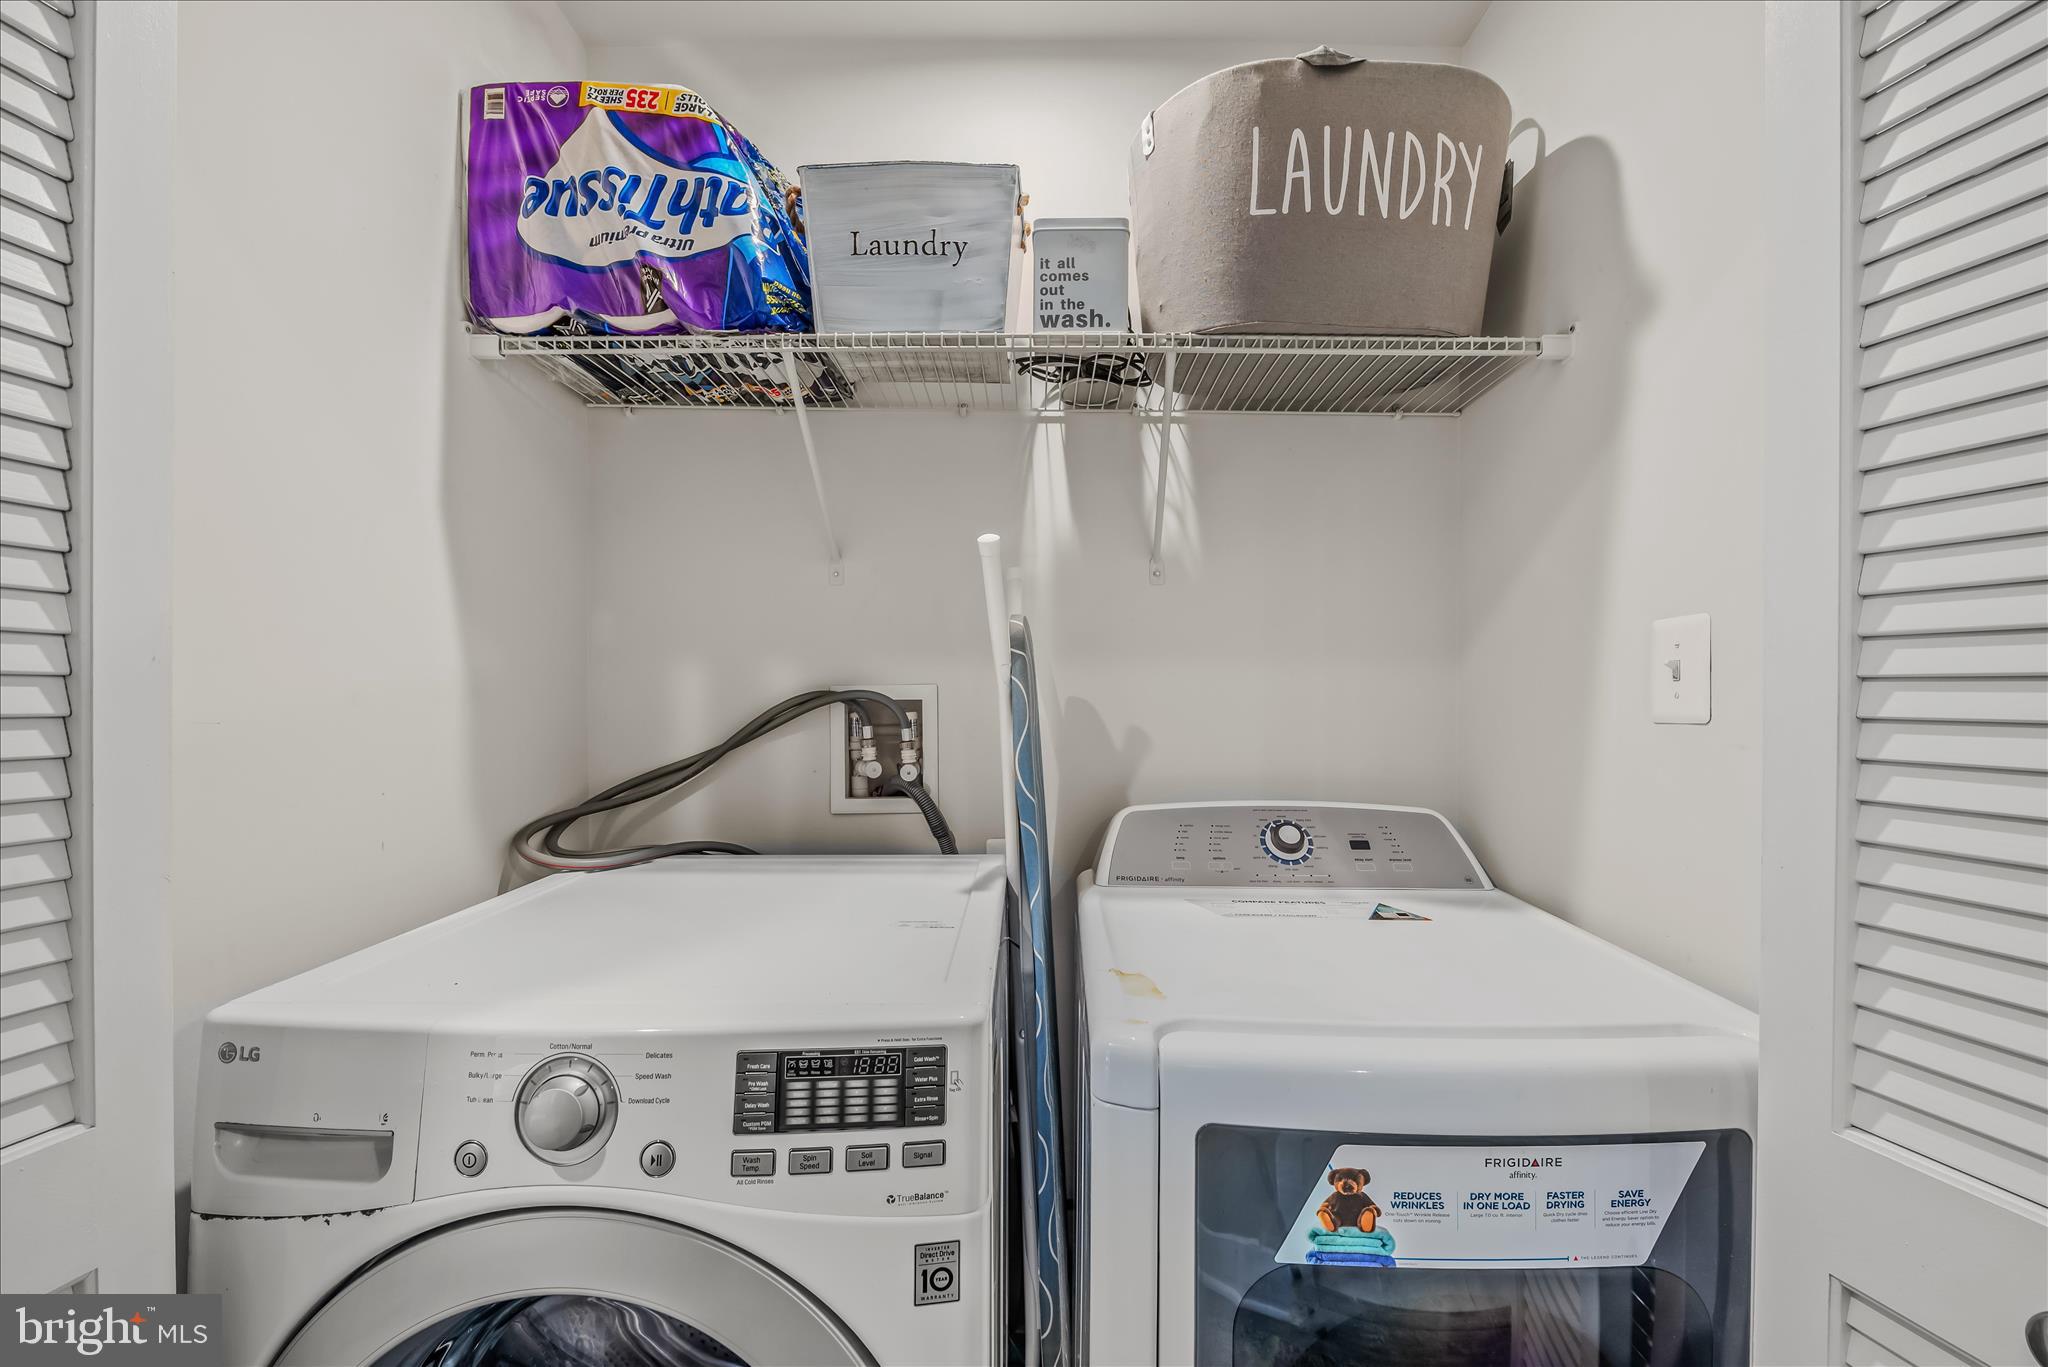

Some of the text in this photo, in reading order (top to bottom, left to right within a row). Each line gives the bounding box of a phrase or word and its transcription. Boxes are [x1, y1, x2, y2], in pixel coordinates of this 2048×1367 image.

[588, 86, 625, 96] PER ROLL
[586, 91, 623, 105] SHEETS
[625, 88, 660, 110] 235
[674, 102, 713, 118] LARGE
[1250, 125, 1483, 231] LAUNDRY
[589, 225, 695, 251] ultra premium
[850, 229, 969, 267] Laundry
[1040, 257, 1076, 270] it all
[1040, 272, 1089, 282] comes
[1040, 284, 1065, 296] out
[1040, 298, 1085, 310] in the
[1040, 309, 1111, 328] wash.
[550, 1043, 592, 1051] Cotton/Normal
[239, 1046, 261, 1062] LG
[468, 1071, 503, 1080] Bulky/Lrge
[742, 1156, 760, 1164] Wash
[803, 1155, 817, 1163] Spin
[913, 1151, 933, 1160] Signal
[800, 1162, 819, 1170] Speed
[858, 1159, 875, 1167] Level
[1485, 1157, 1563, 1168] FRIGIDAIRE
[1393, 1192, 1442, 1200] REDUCES
[1546, 1191, 1585, 1200] FASTER
[1619, 1190, 1644, 1198] SAVE
[1390, 1201, 1445, 1210] WRINKLES
[1463, 1201, 1531, 1210] IN ONE LOAD
[1546, 1201, 1585, 1209] DRYING
[1611, 1199, 1651, 1208] ENERGY
[921, 1267, 953, 1293] 10
[921, 1293, 954, 1301] WARRANTY
